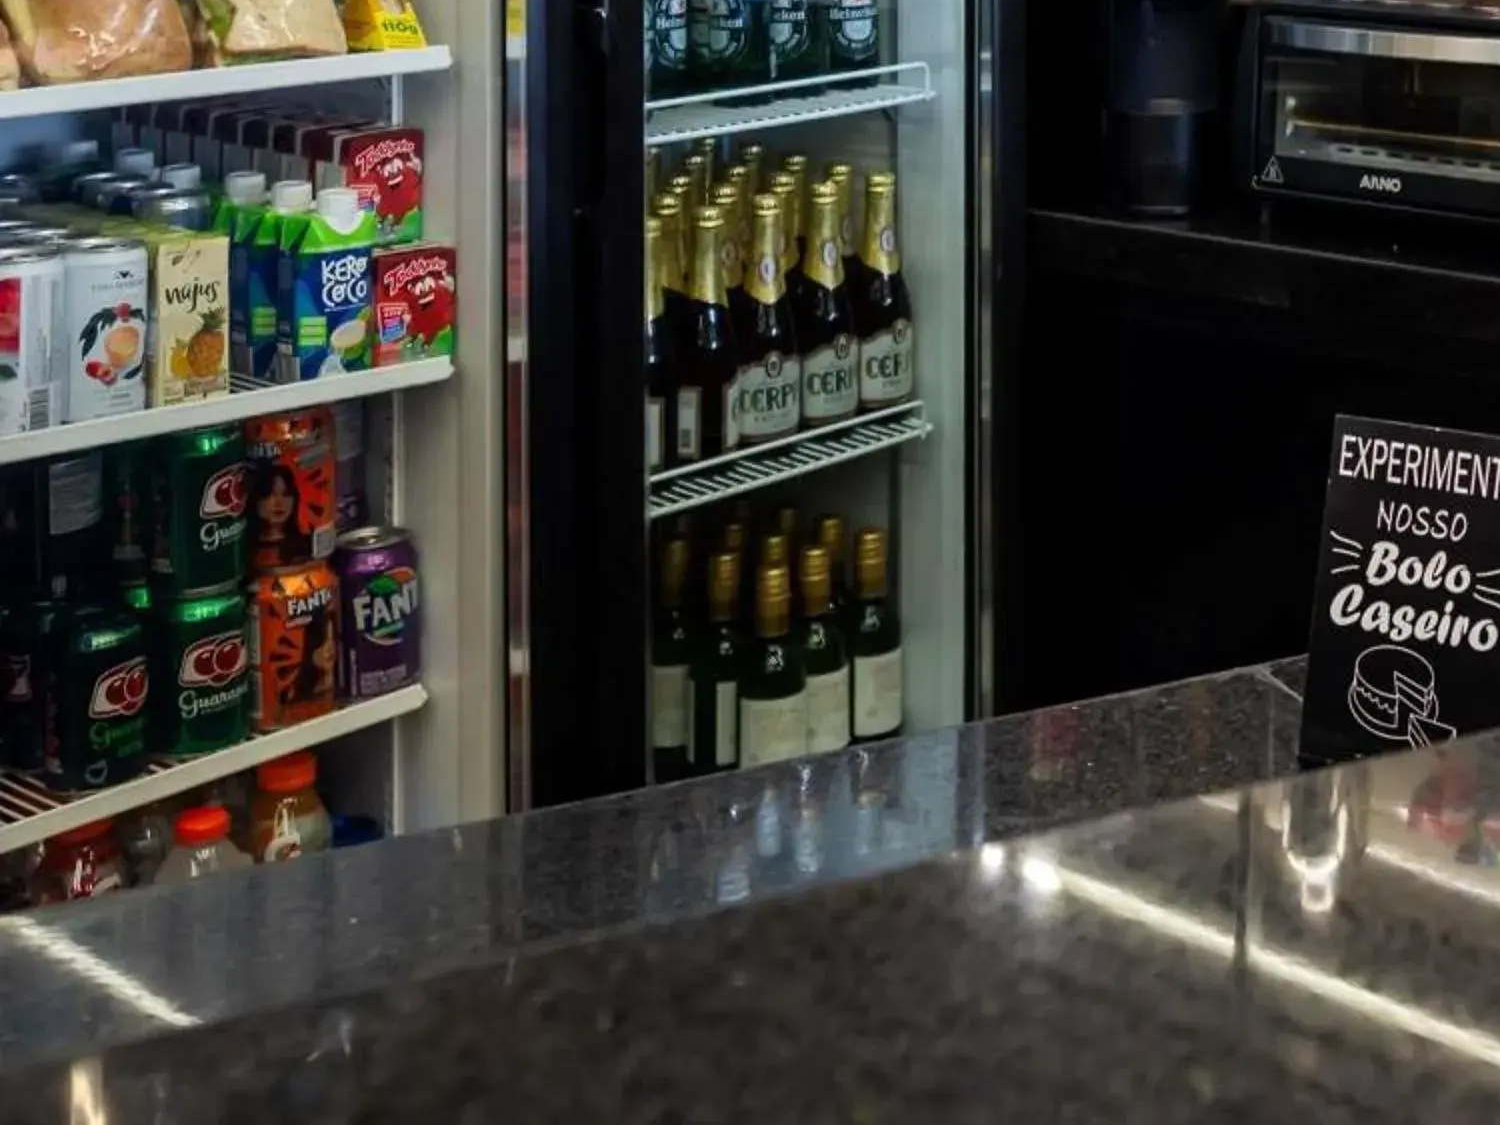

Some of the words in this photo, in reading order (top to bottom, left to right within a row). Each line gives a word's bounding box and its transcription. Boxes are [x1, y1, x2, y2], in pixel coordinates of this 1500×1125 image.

[321, 255, 368, 285] KERO
[165, 277, 220, 313] najus
[321, 279, 367, 307] COCO
[1376, 499, 1468, 542] NOSSO
[1366, 541, 1472, 594] Bolo
[353, 579, 419, 630] FANT
[1329, 584, 1499, 652] Caseiro
